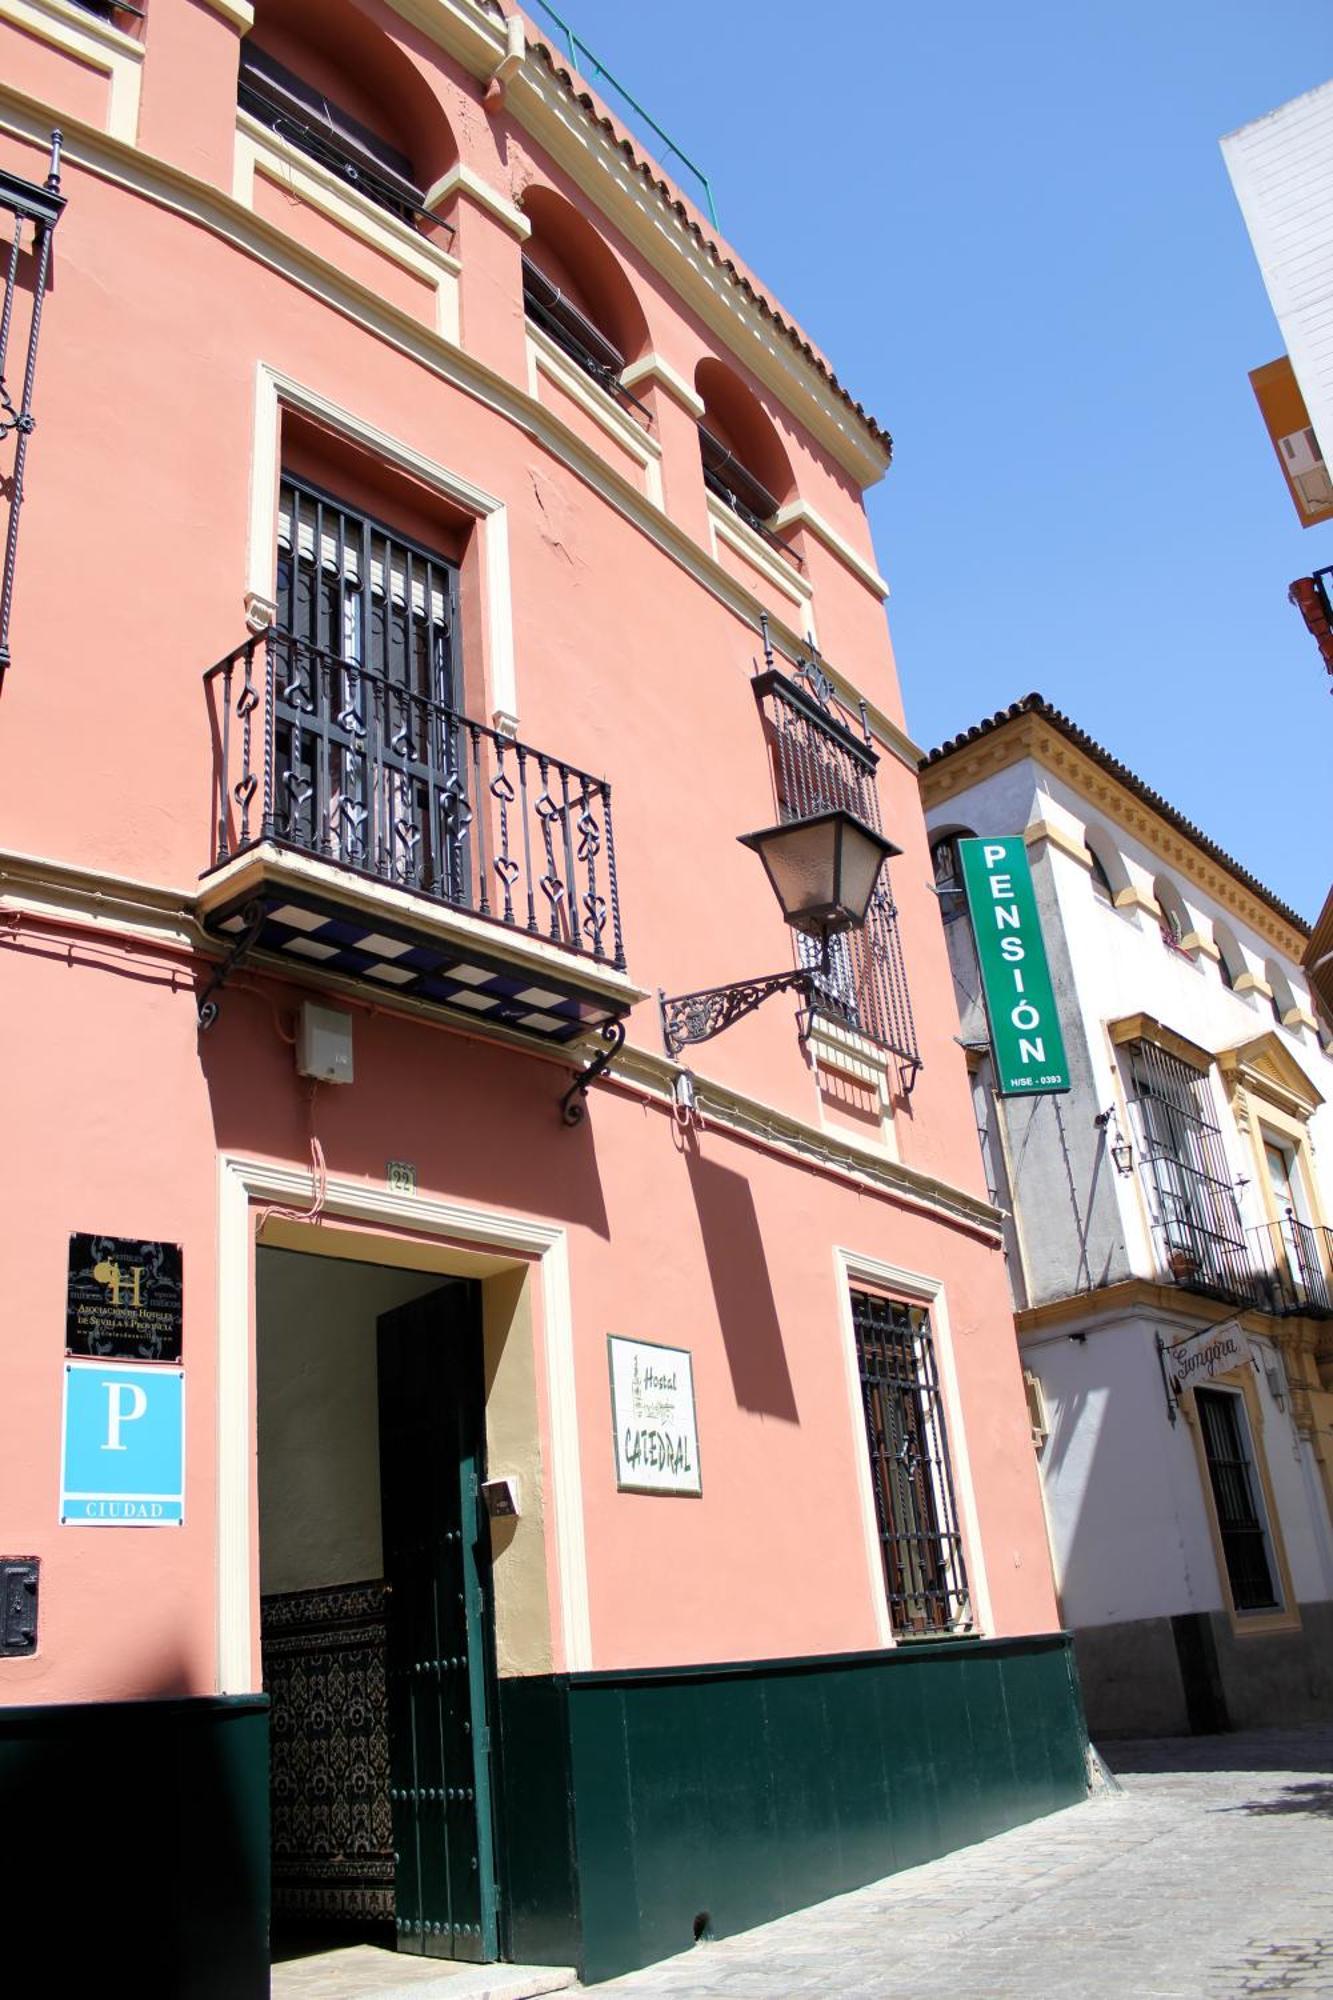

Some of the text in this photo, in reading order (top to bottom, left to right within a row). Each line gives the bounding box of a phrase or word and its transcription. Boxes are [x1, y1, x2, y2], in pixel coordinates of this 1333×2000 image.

[983, 845, 1047, 1064] PENSIÓN
[393, 1170, 410, 1191] 22
[644, 1366, 677, 1391] Hostal
[100, 1381, 147, 1451] P
[625, 1426, 691, 1476] CATEDRAL
[85, 1502, 163, 1518] CIUDAD
